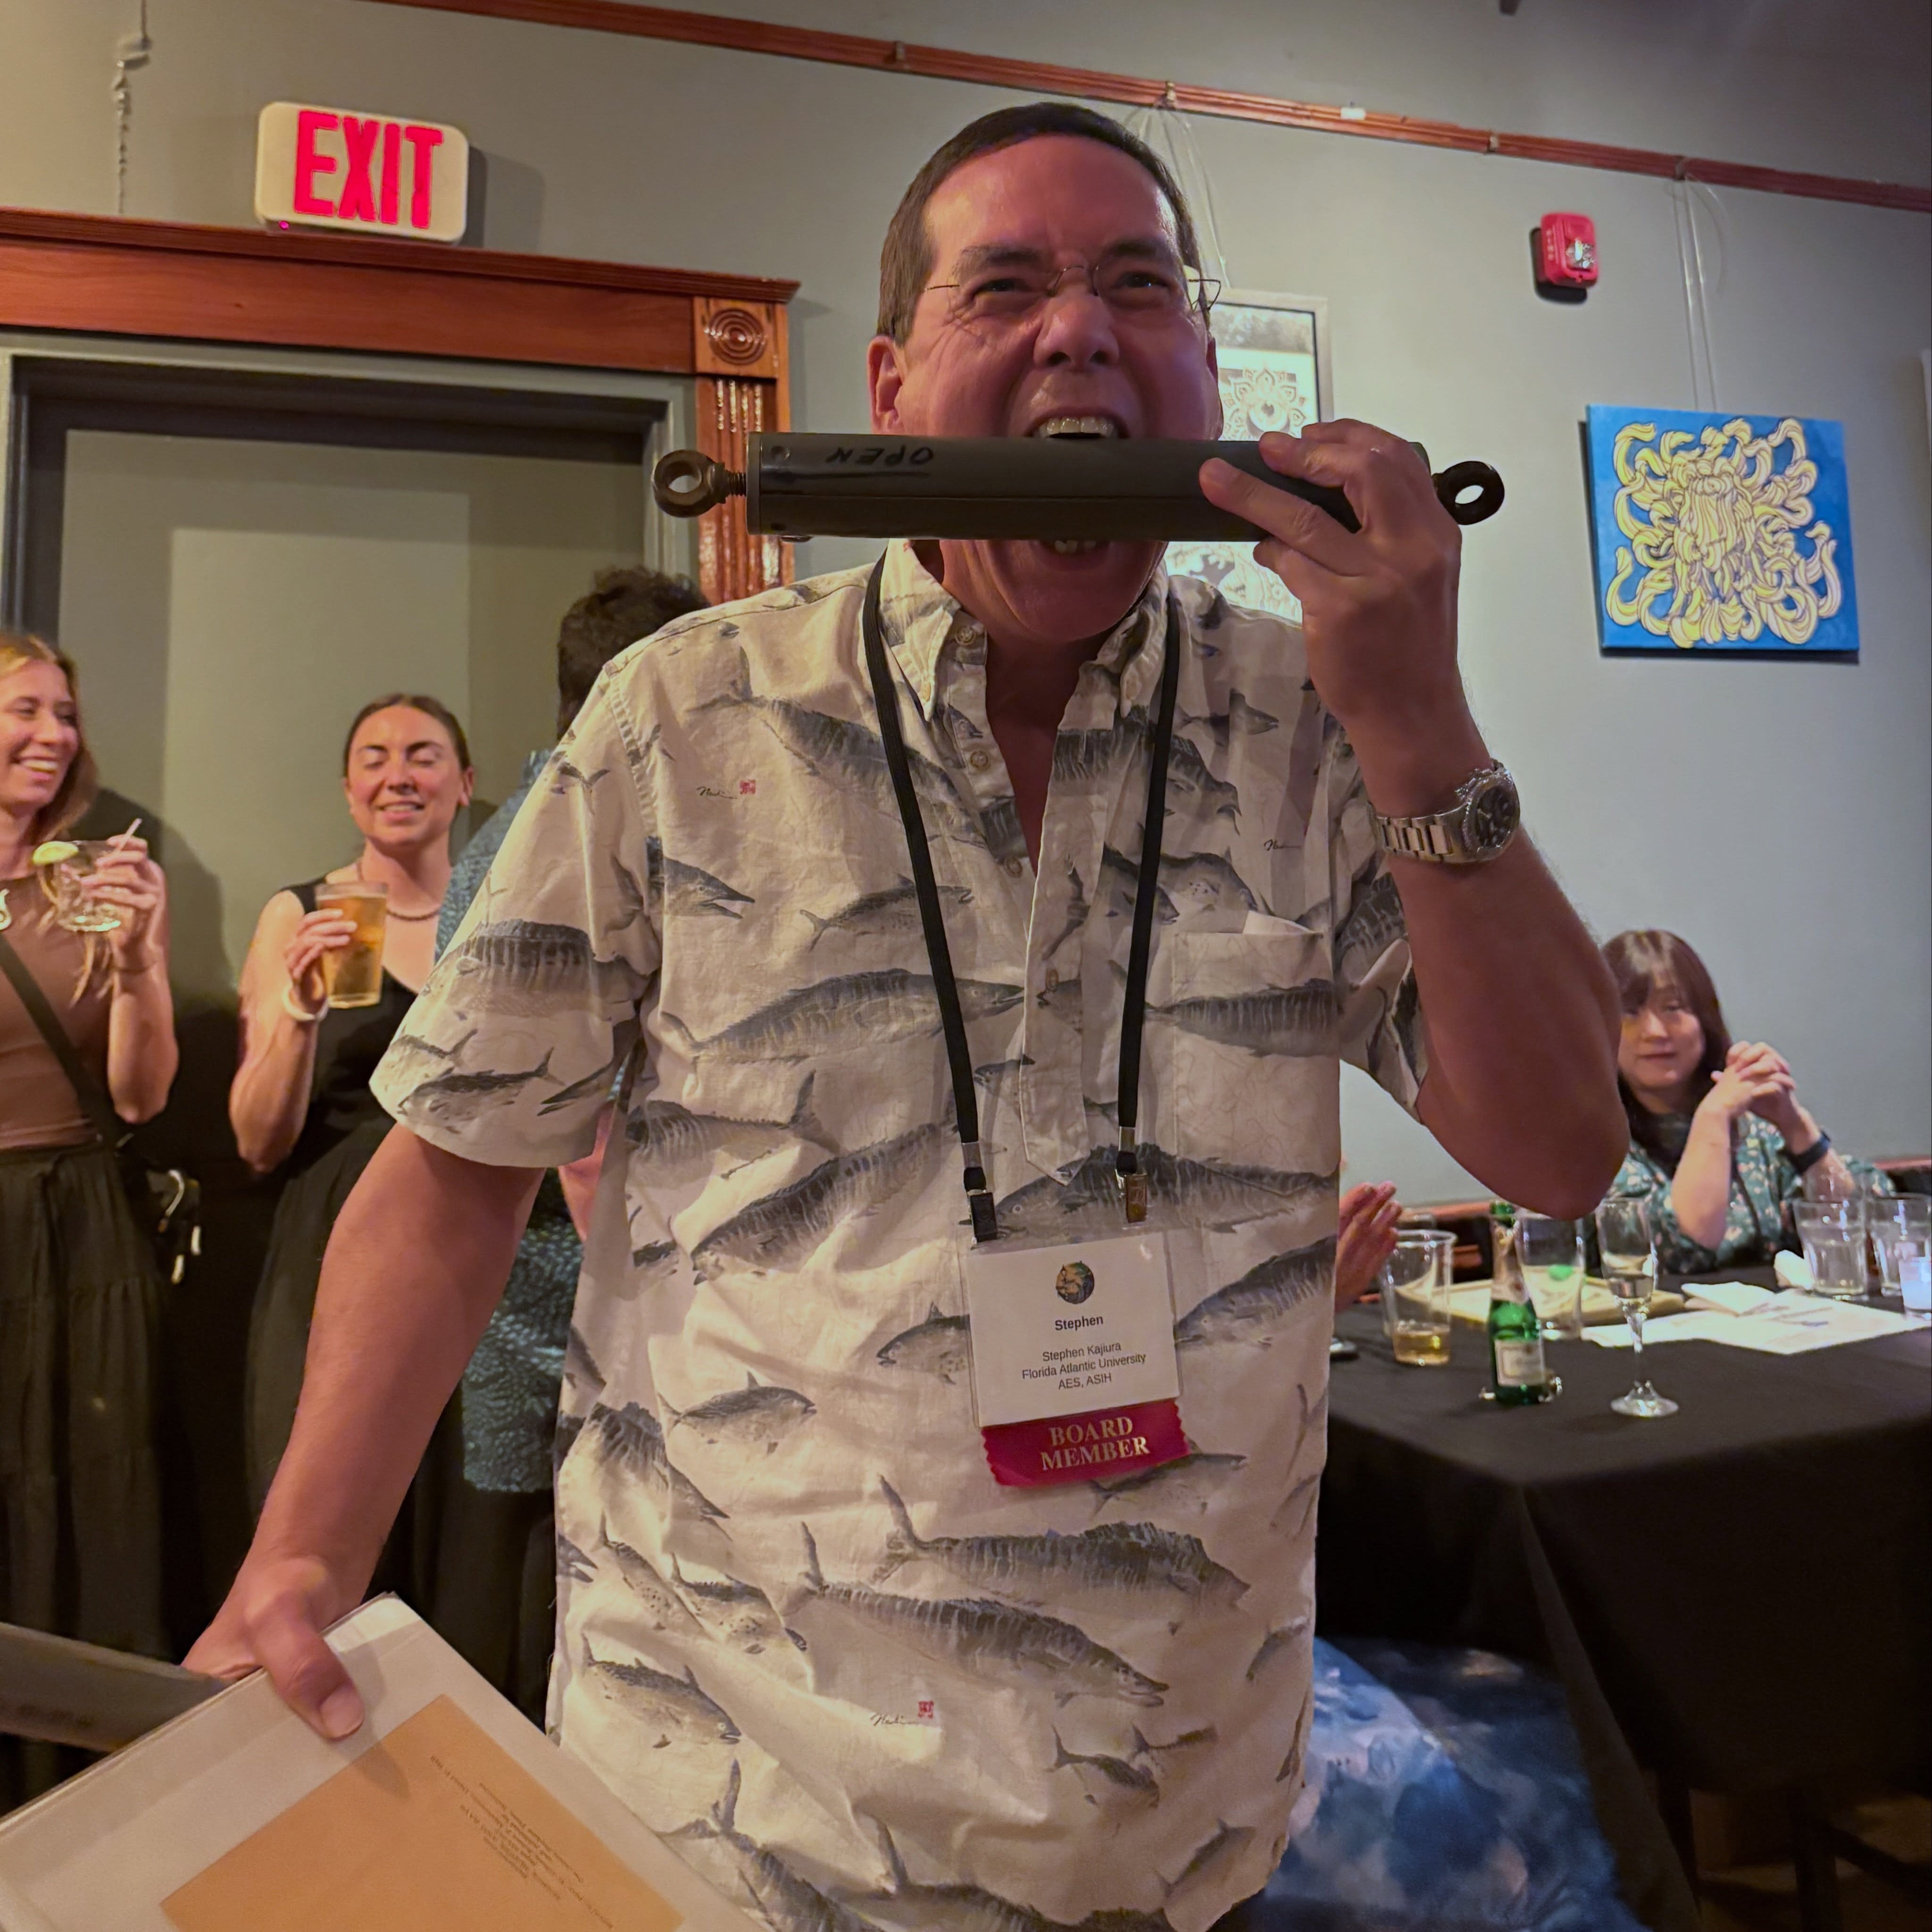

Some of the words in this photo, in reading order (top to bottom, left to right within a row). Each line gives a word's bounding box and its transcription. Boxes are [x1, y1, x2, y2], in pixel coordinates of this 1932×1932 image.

[293, 109, 443, 229] EXIT
[826, 444, 934, 464] OPEN
[1055, 1315, 1103, 1330] Stephen
[1042, 1348, 1084, 1362] Stephen
[1087, 1342, 1122, 1356] Kajiura
[1022, 1366, 1057, 1380] Florida
[1059, 1361, 1096, 1375] Atlantic
[1099, 1353, 1146, 1370] University
[1058, 1377, 1084, 1389] AES,
[1086, 1373, 1112, 1386] ASIH
[1049, 1417, 1133, 1447] BOARD
[1041, 1437, 1150, 1471] MEMBER
